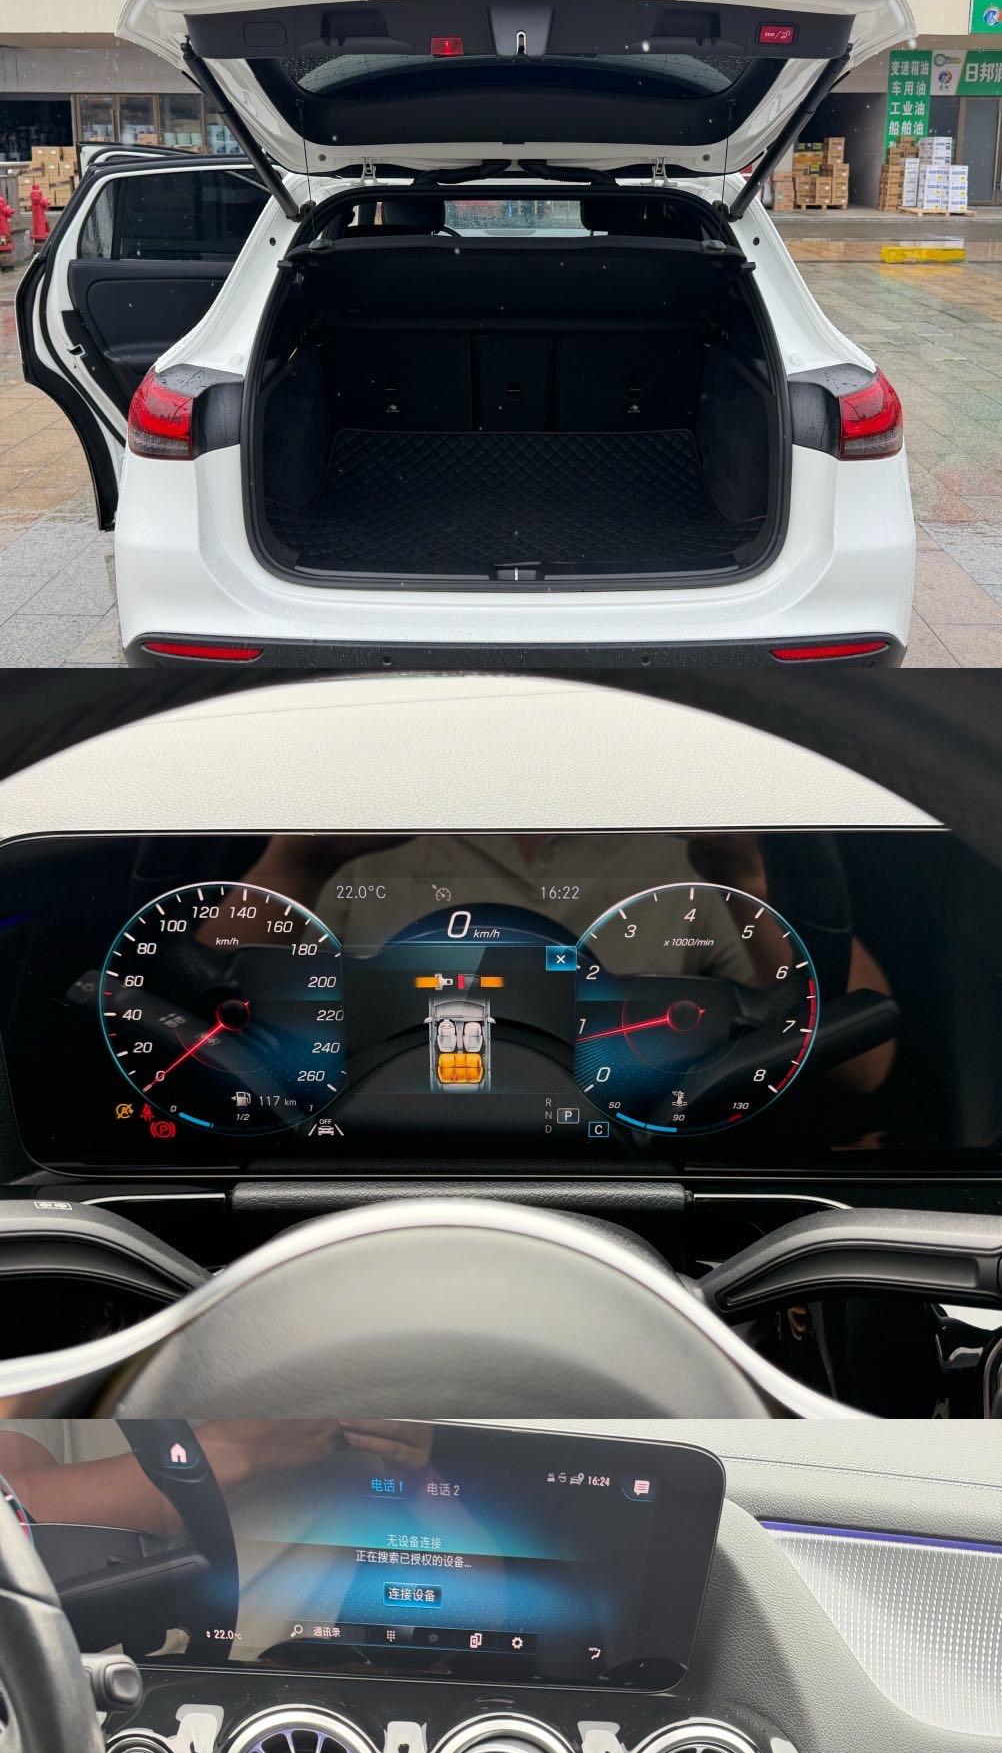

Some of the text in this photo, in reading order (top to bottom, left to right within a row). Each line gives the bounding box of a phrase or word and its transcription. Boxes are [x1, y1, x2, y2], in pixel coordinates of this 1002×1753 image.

[890, 59, 930, 76] 变速箱油
[891, 80, 927, 96] 车用油
[890, 100, 926, 116] 工业油
[888, 120, 925, 136] 船舶油
[336, 885, 387, 899] 22.0°C
[540, 885, 580, 900] 16:22
[192, 906, 219, 919] 120
[230, 906, 257, 919] 140
[684, 908, 697, 922] 4
[159, 920, 187, 932] 100
[266, 921, 293, 933] 160
[447, 911, 500, 939] 0 km/h
[624, 924, 637, 938] 3
[741, 925, 754, 939] 5
[215, 937, 239, 946] km/h
[136, 943, 157, 955] 80
[290, 944, 317, 956] 180
[586, 965, 600, 980] 2
[776, 966, 789, 980] 6
[124, 976, 144, 988] 60
[308, 976, 336, 988] 200
[122, 1009, 142, 1021] 40
[316, 1010, 344, 1021] 220
[578, 1018, 587, 1034] 1
[782, 1020, 796, 1034] 7
[133, 1042, 153, 1054] 20
[312, 1042, 340, 1054] 240
[155, 1070, 166, 1082] 0
[297, 1070, 325, 1082] 260
[596, 1067, 611, 1082] 0
[753, 1069, 766, 1082] 8
[259, 1096, 297, 1107] 117 km
[545, 1098, 552, 1106] R
[733, 1102, 750, 1110] 130
[170, 1105, 177, 1113] 0
[236, 1113, 250, 1121] 1/2
[545, 1112, 552, 1120] N
[545, 1125, 552, 1133] D
[371, 1478, 395, 1492] 电话
[588, 1475, 610, 1487] 16:24
[427, 1482, 460, 1496] 电话 2
[387, 1534, 442, 1550] 无设备连接
[388, 1586, 436, 1602] 连接设备
[313, 1626, 341, 1638] 通讯录
